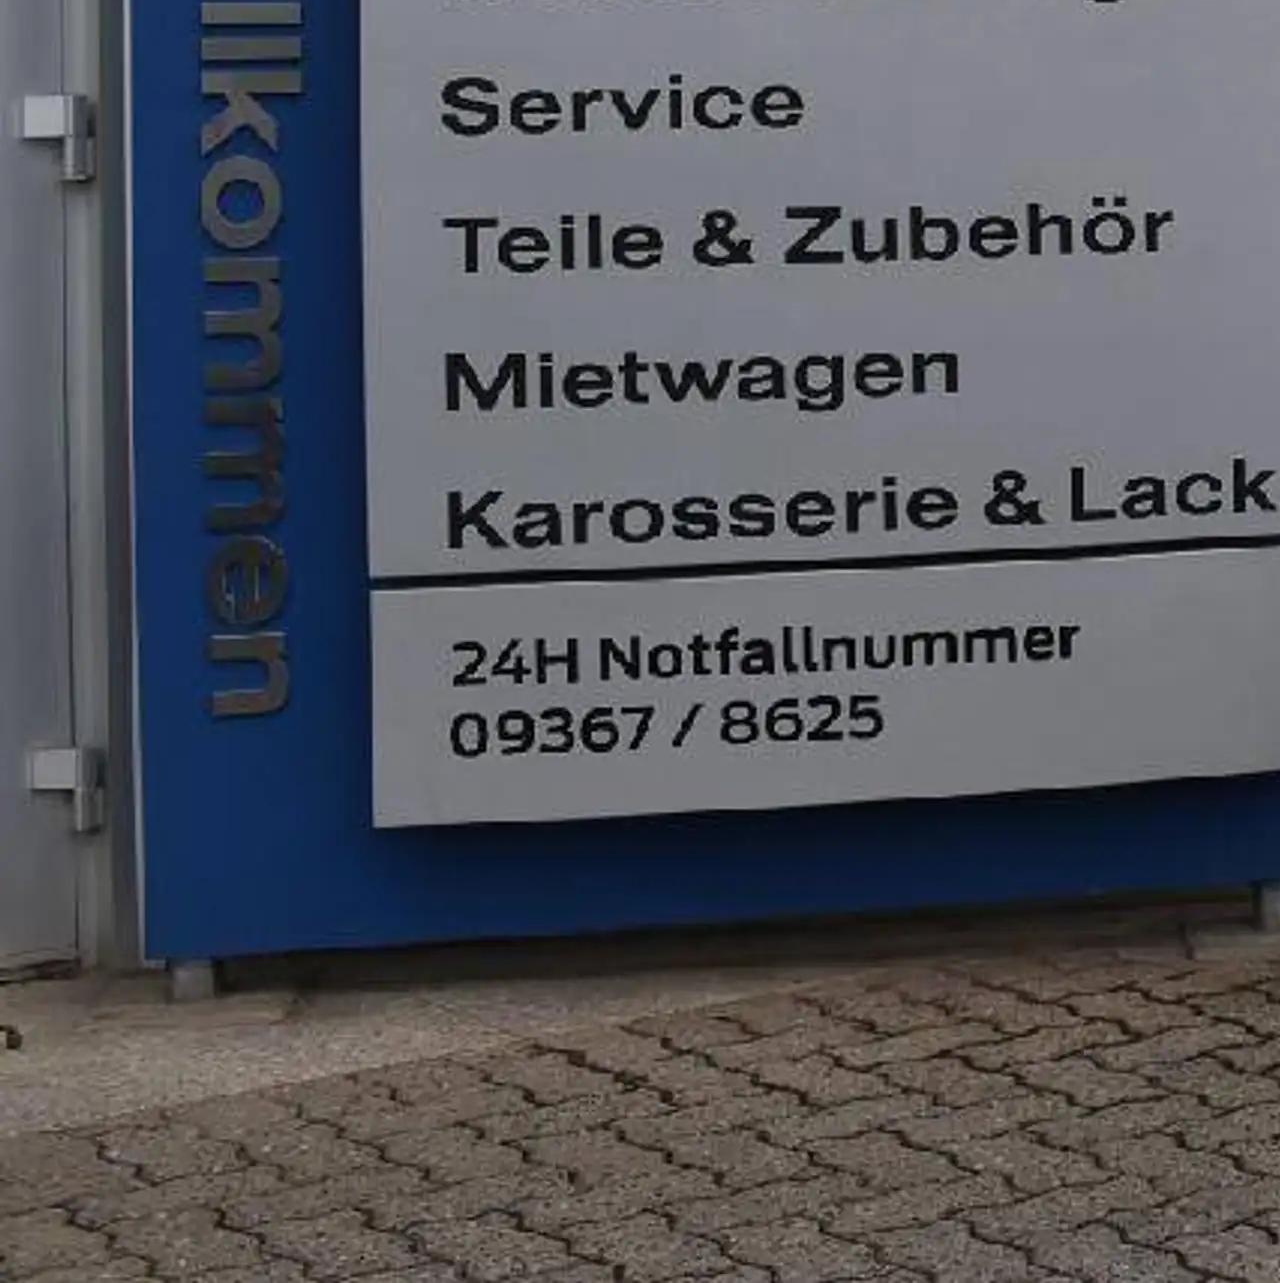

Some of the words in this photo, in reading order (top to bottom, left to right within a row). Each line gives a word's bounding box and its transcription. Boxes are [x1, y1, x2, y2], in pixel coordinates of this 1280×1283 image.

[441, 74, 805, 137] Service
[442, 213, 664, 274] Teile
[692, 209, 755, 267] &
[784, 196, 1174, 265] Zubehör
[445, 351, 959, 413] Mietwagen
[447, 476, 959, 550] Karosserie
[983, 469, 1046, 526] &
[1070, 458, 1277, 522] Lack
[451, 637, 580, 687] 24H
[599, 623, 1081, 682] Notfallnummer
[449, 705, 655, 759] 09367
[671, 702, 705, 749] /
[719, 694, 884, 745] 8625
